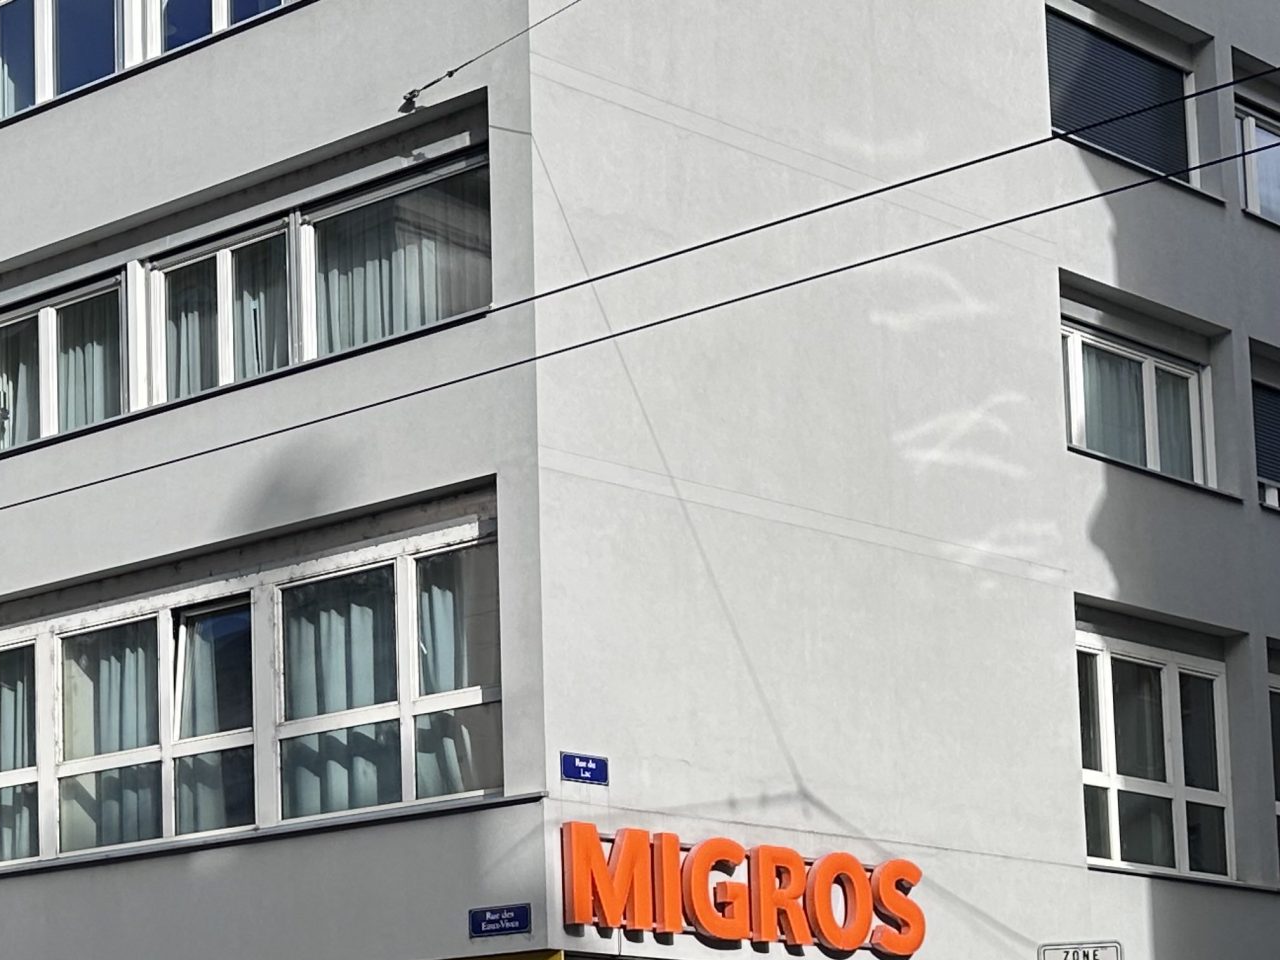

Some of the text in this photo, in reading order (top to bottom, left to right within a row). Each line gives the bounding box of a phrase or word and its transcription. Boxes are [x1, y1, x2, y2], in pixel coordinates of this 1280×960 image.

[485, 909, 514, 920] Rue des
[562, 821, 926, 955] MIGROS
